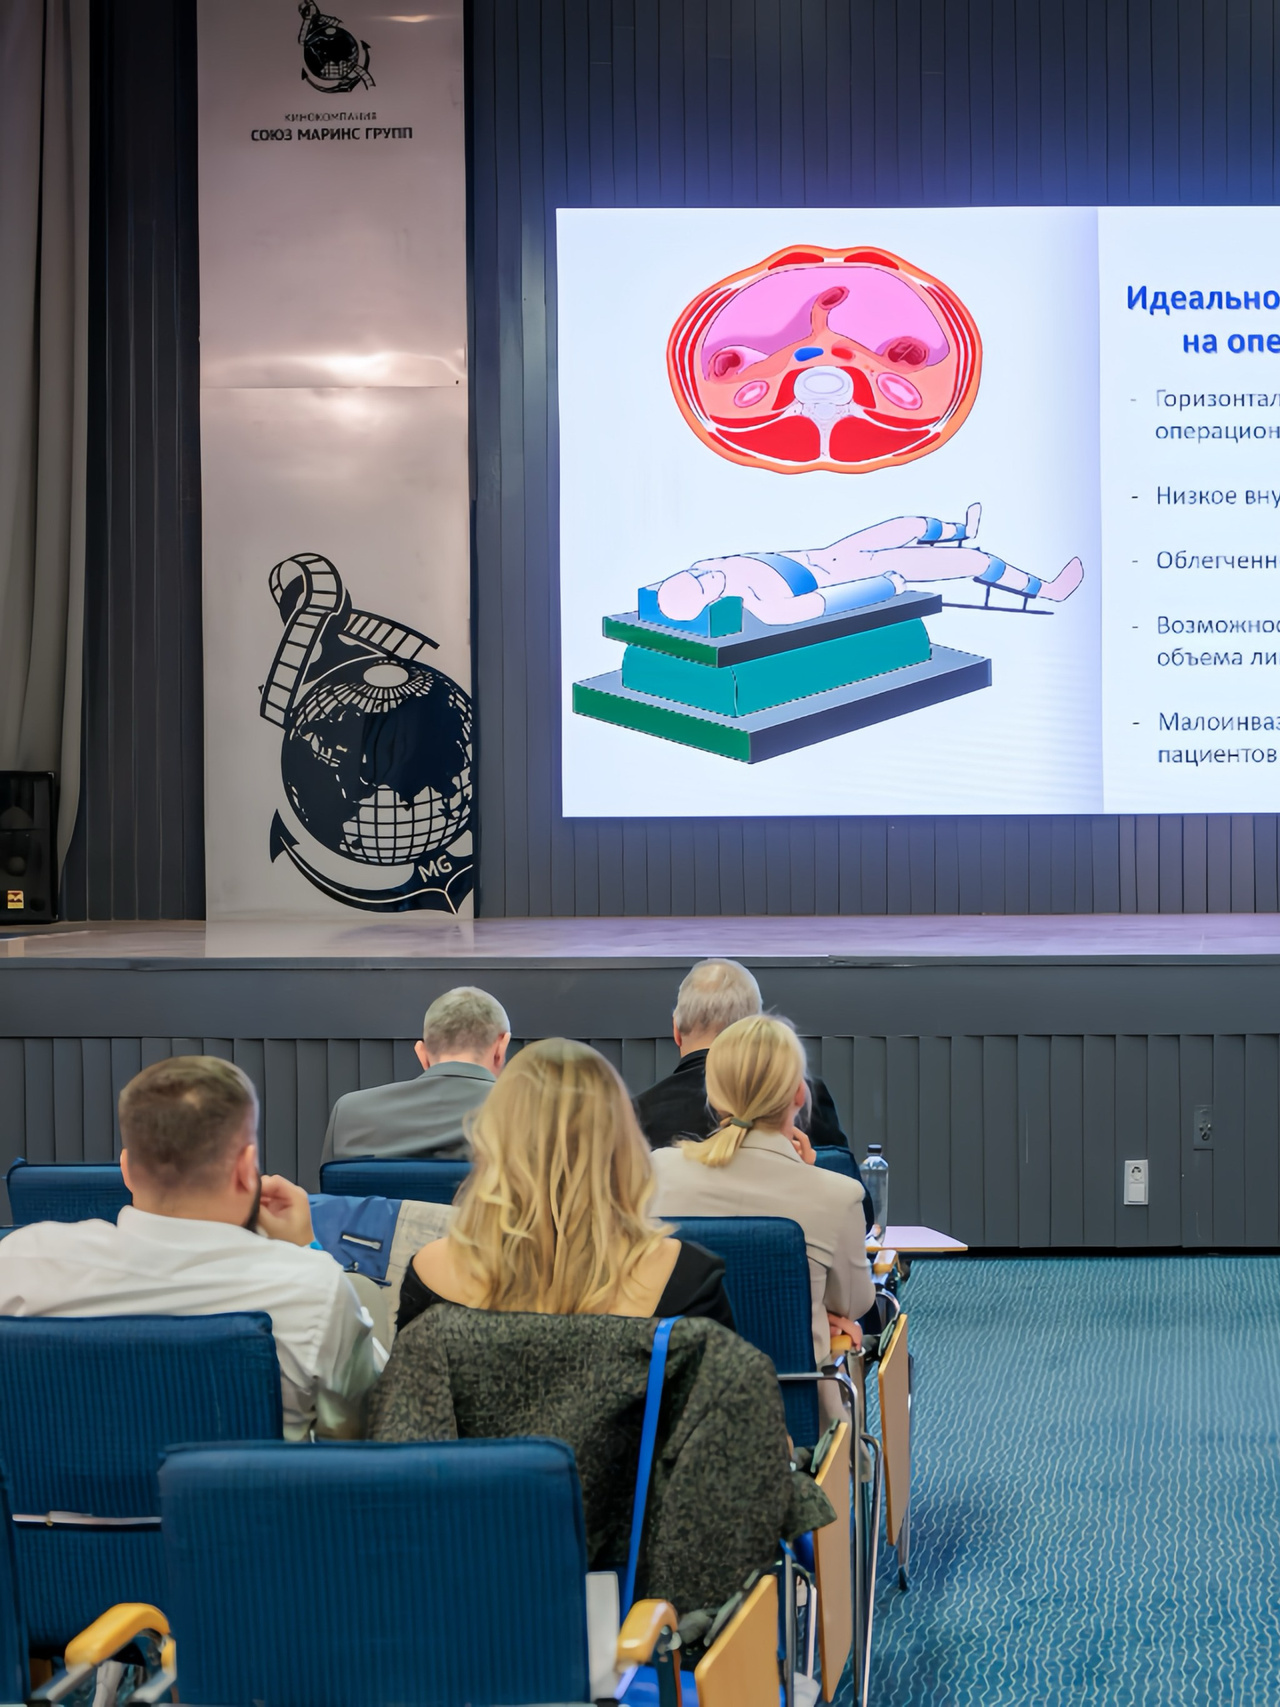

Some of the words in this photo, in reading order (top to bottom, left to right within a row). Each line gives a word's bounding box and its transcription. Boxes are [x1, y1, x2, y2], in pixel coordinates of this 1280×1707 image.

[251, 128, 292, 141] СОЮЗ
[297, 127, 360, 141] МАРИНС
[365, 127, 413, 140] ГРУПП
[1182, 333, 1218, 355] на
[1157, 486, 1237, 506] Низкое
[1157, 647, 1243, 667] объема
[1157, 747, 1278, 768] пациентов
[418, 855, 453, 882] MG
